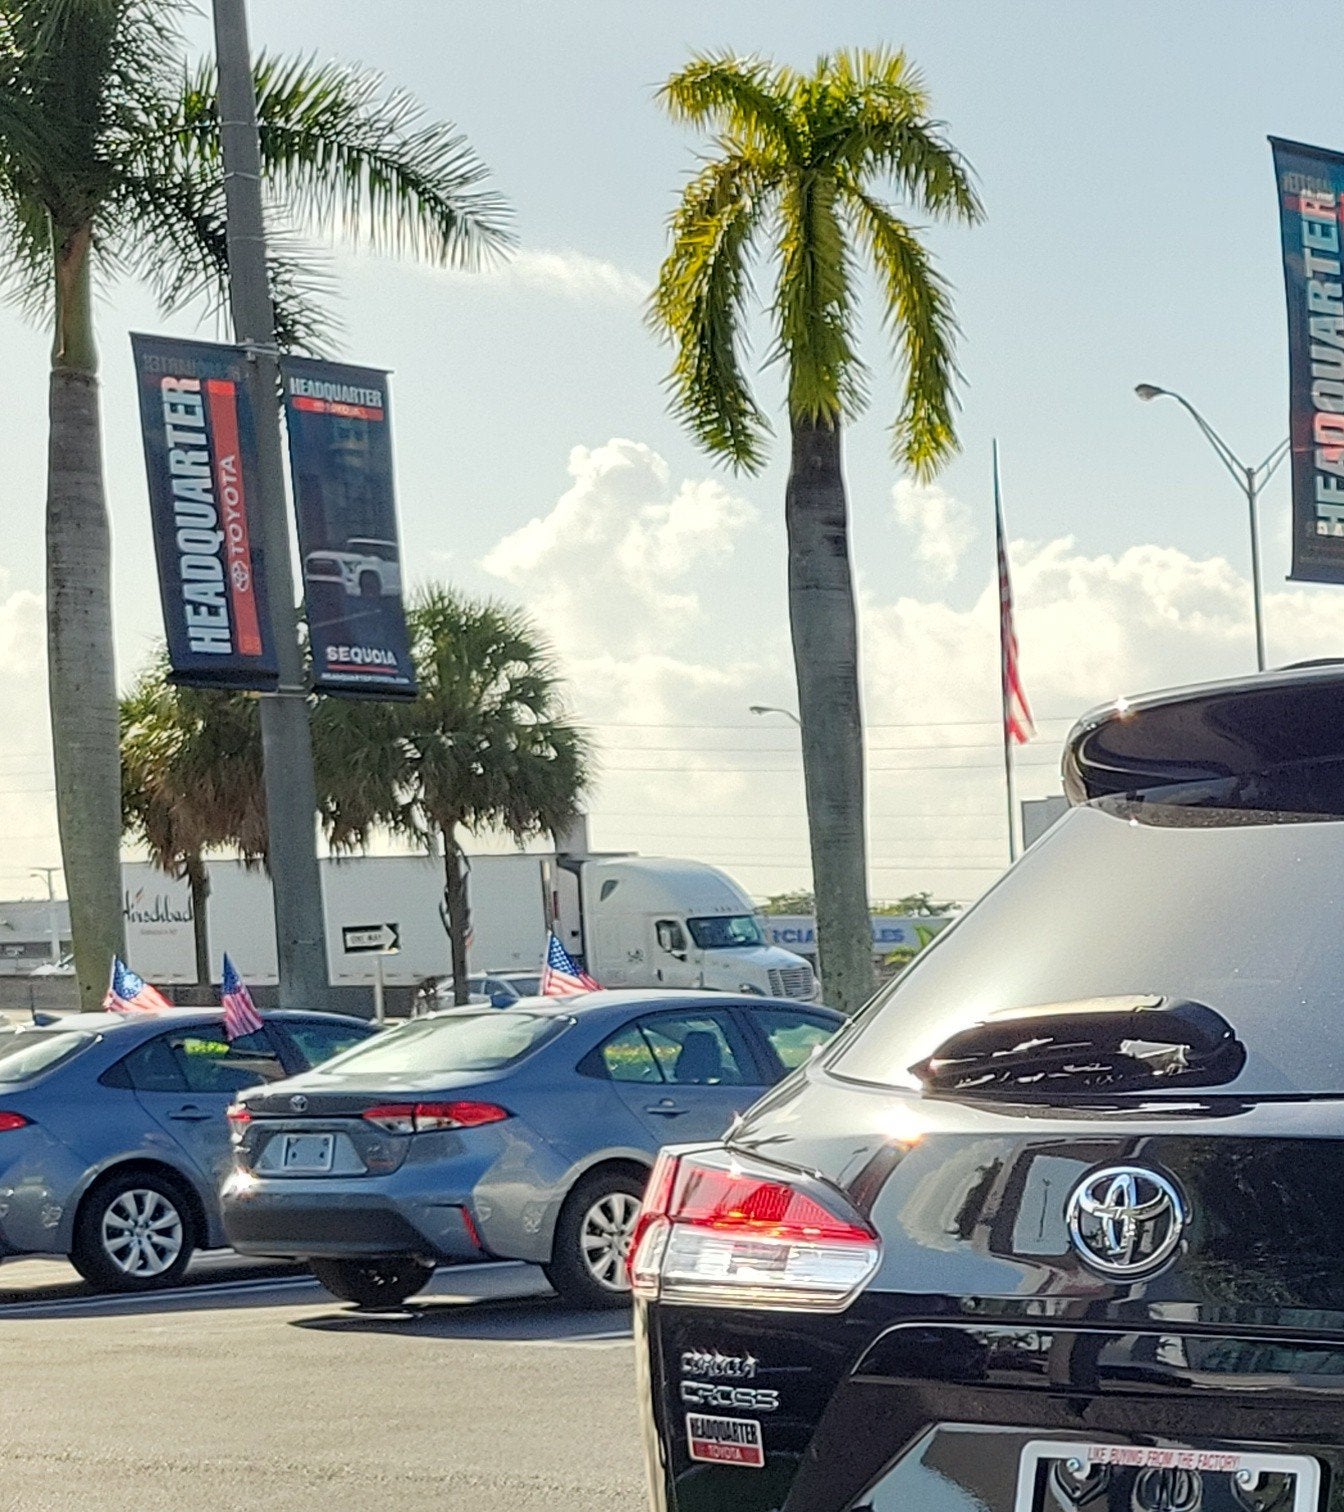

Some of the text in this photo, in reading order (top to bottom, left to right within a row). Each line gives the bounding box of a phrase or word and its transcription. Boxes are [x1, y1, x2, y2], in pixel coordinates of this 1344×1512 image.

[289, 377, 383, 408] HEADQUARTER
[161, 377, 232, 654] HEADQUARTER
[218, 454, 250, 555] TOYOTA
[325, 645, 398, 666] SEQUOIA
[680, 1380, 779, 1412] CROSS
[689, 1417, 759, 1445] HEADQUARTER
[1087, 1446, 1106, 1463] LIKE
[1110, 1448, 1143, 1467] BUYING
[1147, 1450, 1174, 1466] FROM
[1179, 1452, 1195, 1467] THE
